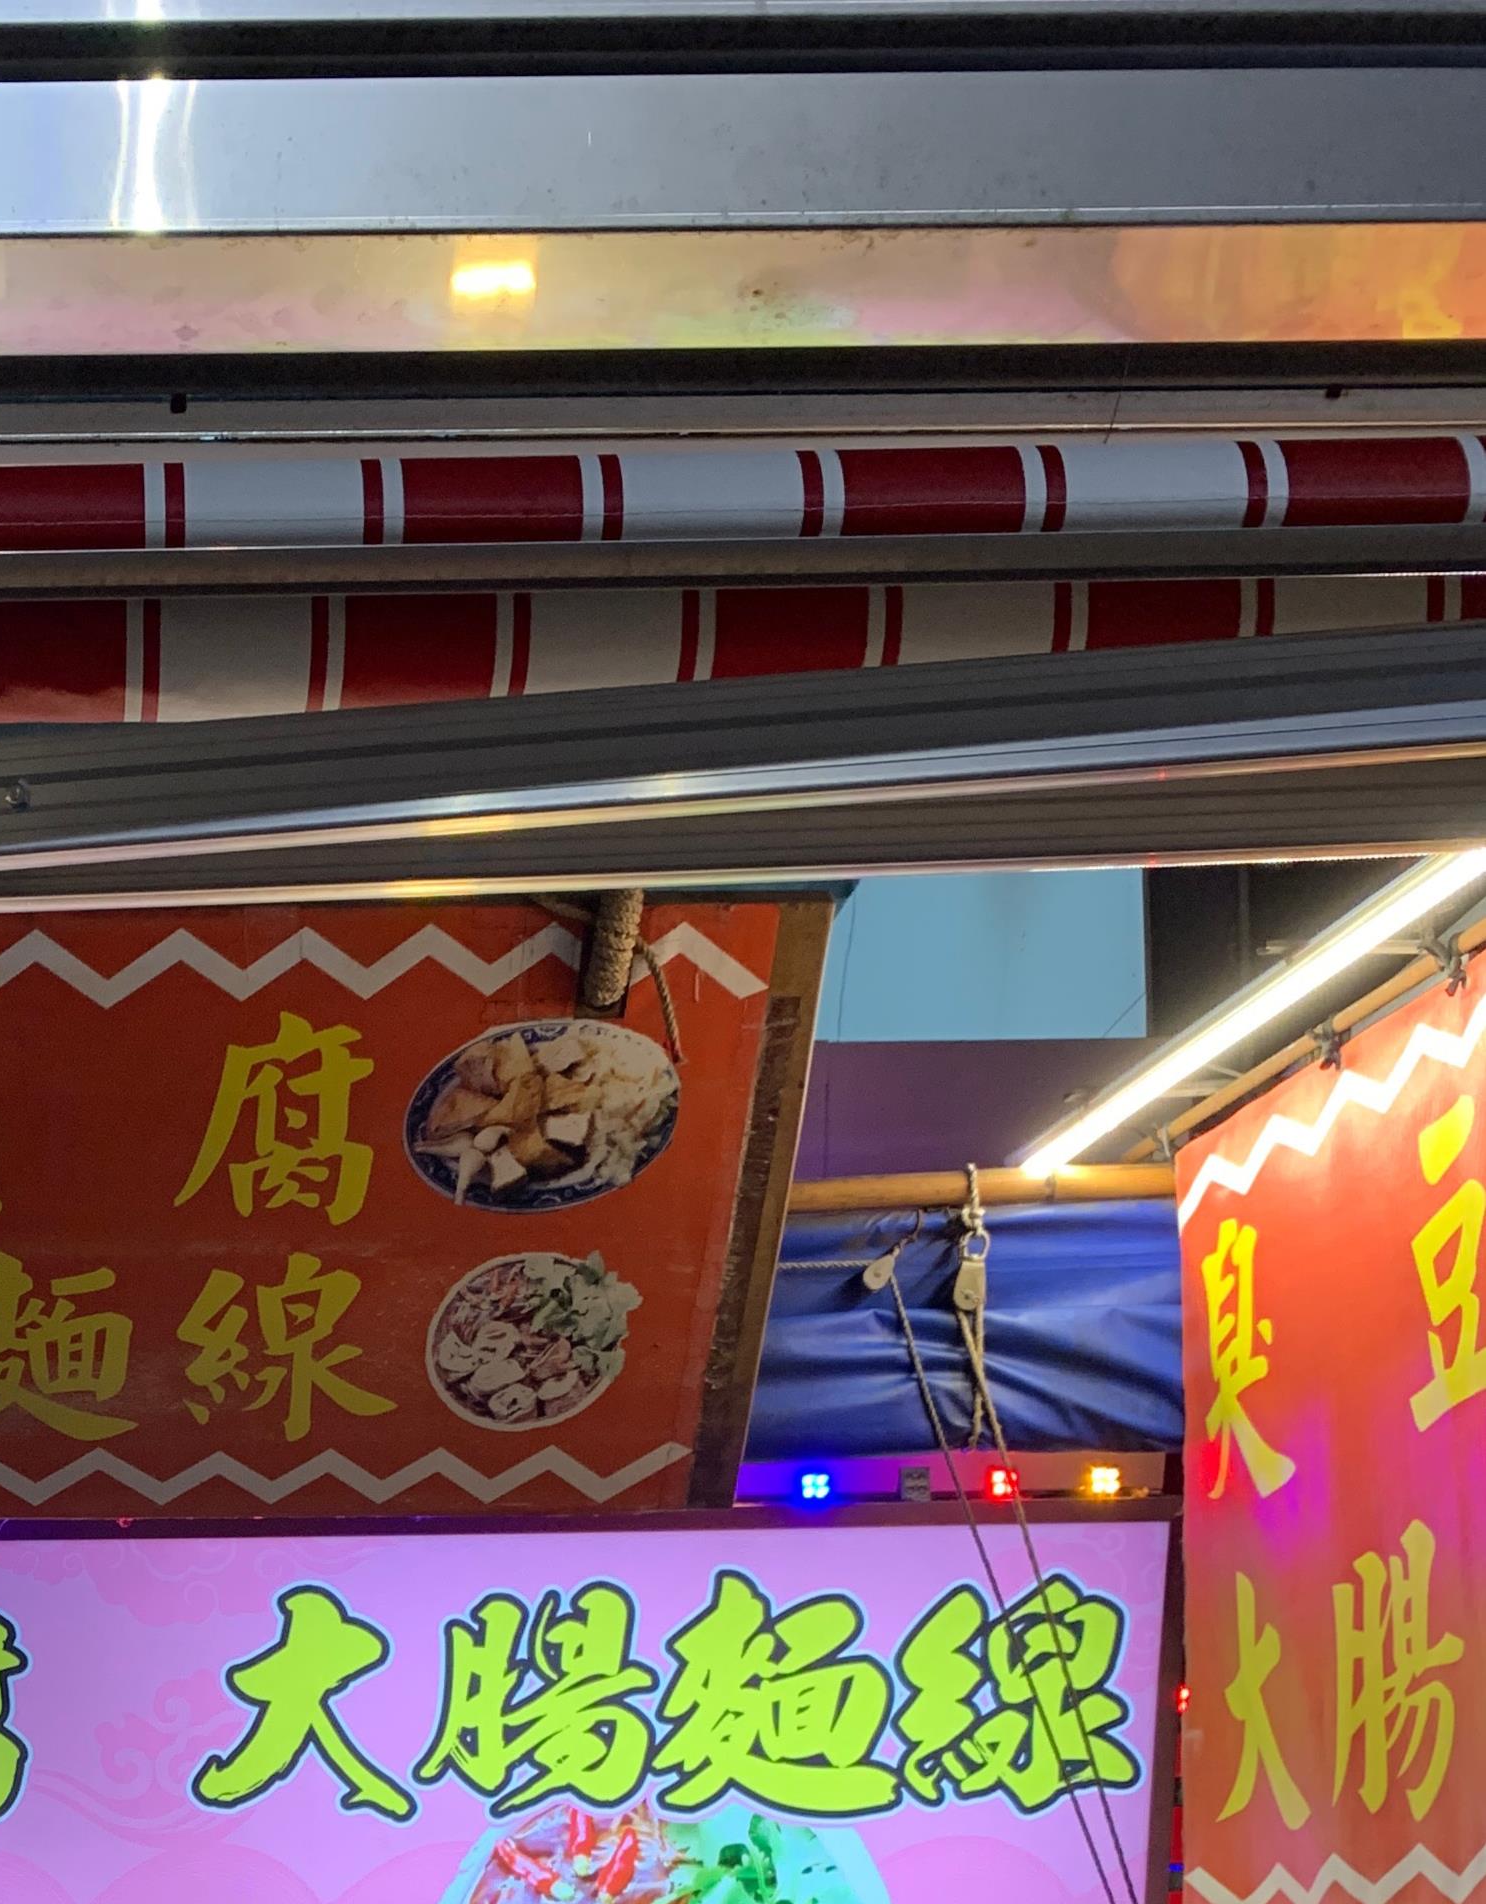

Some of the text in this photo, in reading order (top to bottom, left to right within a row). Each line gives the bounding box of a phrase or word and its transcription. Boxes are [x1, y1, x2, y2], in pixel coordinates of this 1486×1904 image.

[192, 1568, 1145, 1817] 大腸麵線
[1216, 1518, 1465, 1832] 大腸
